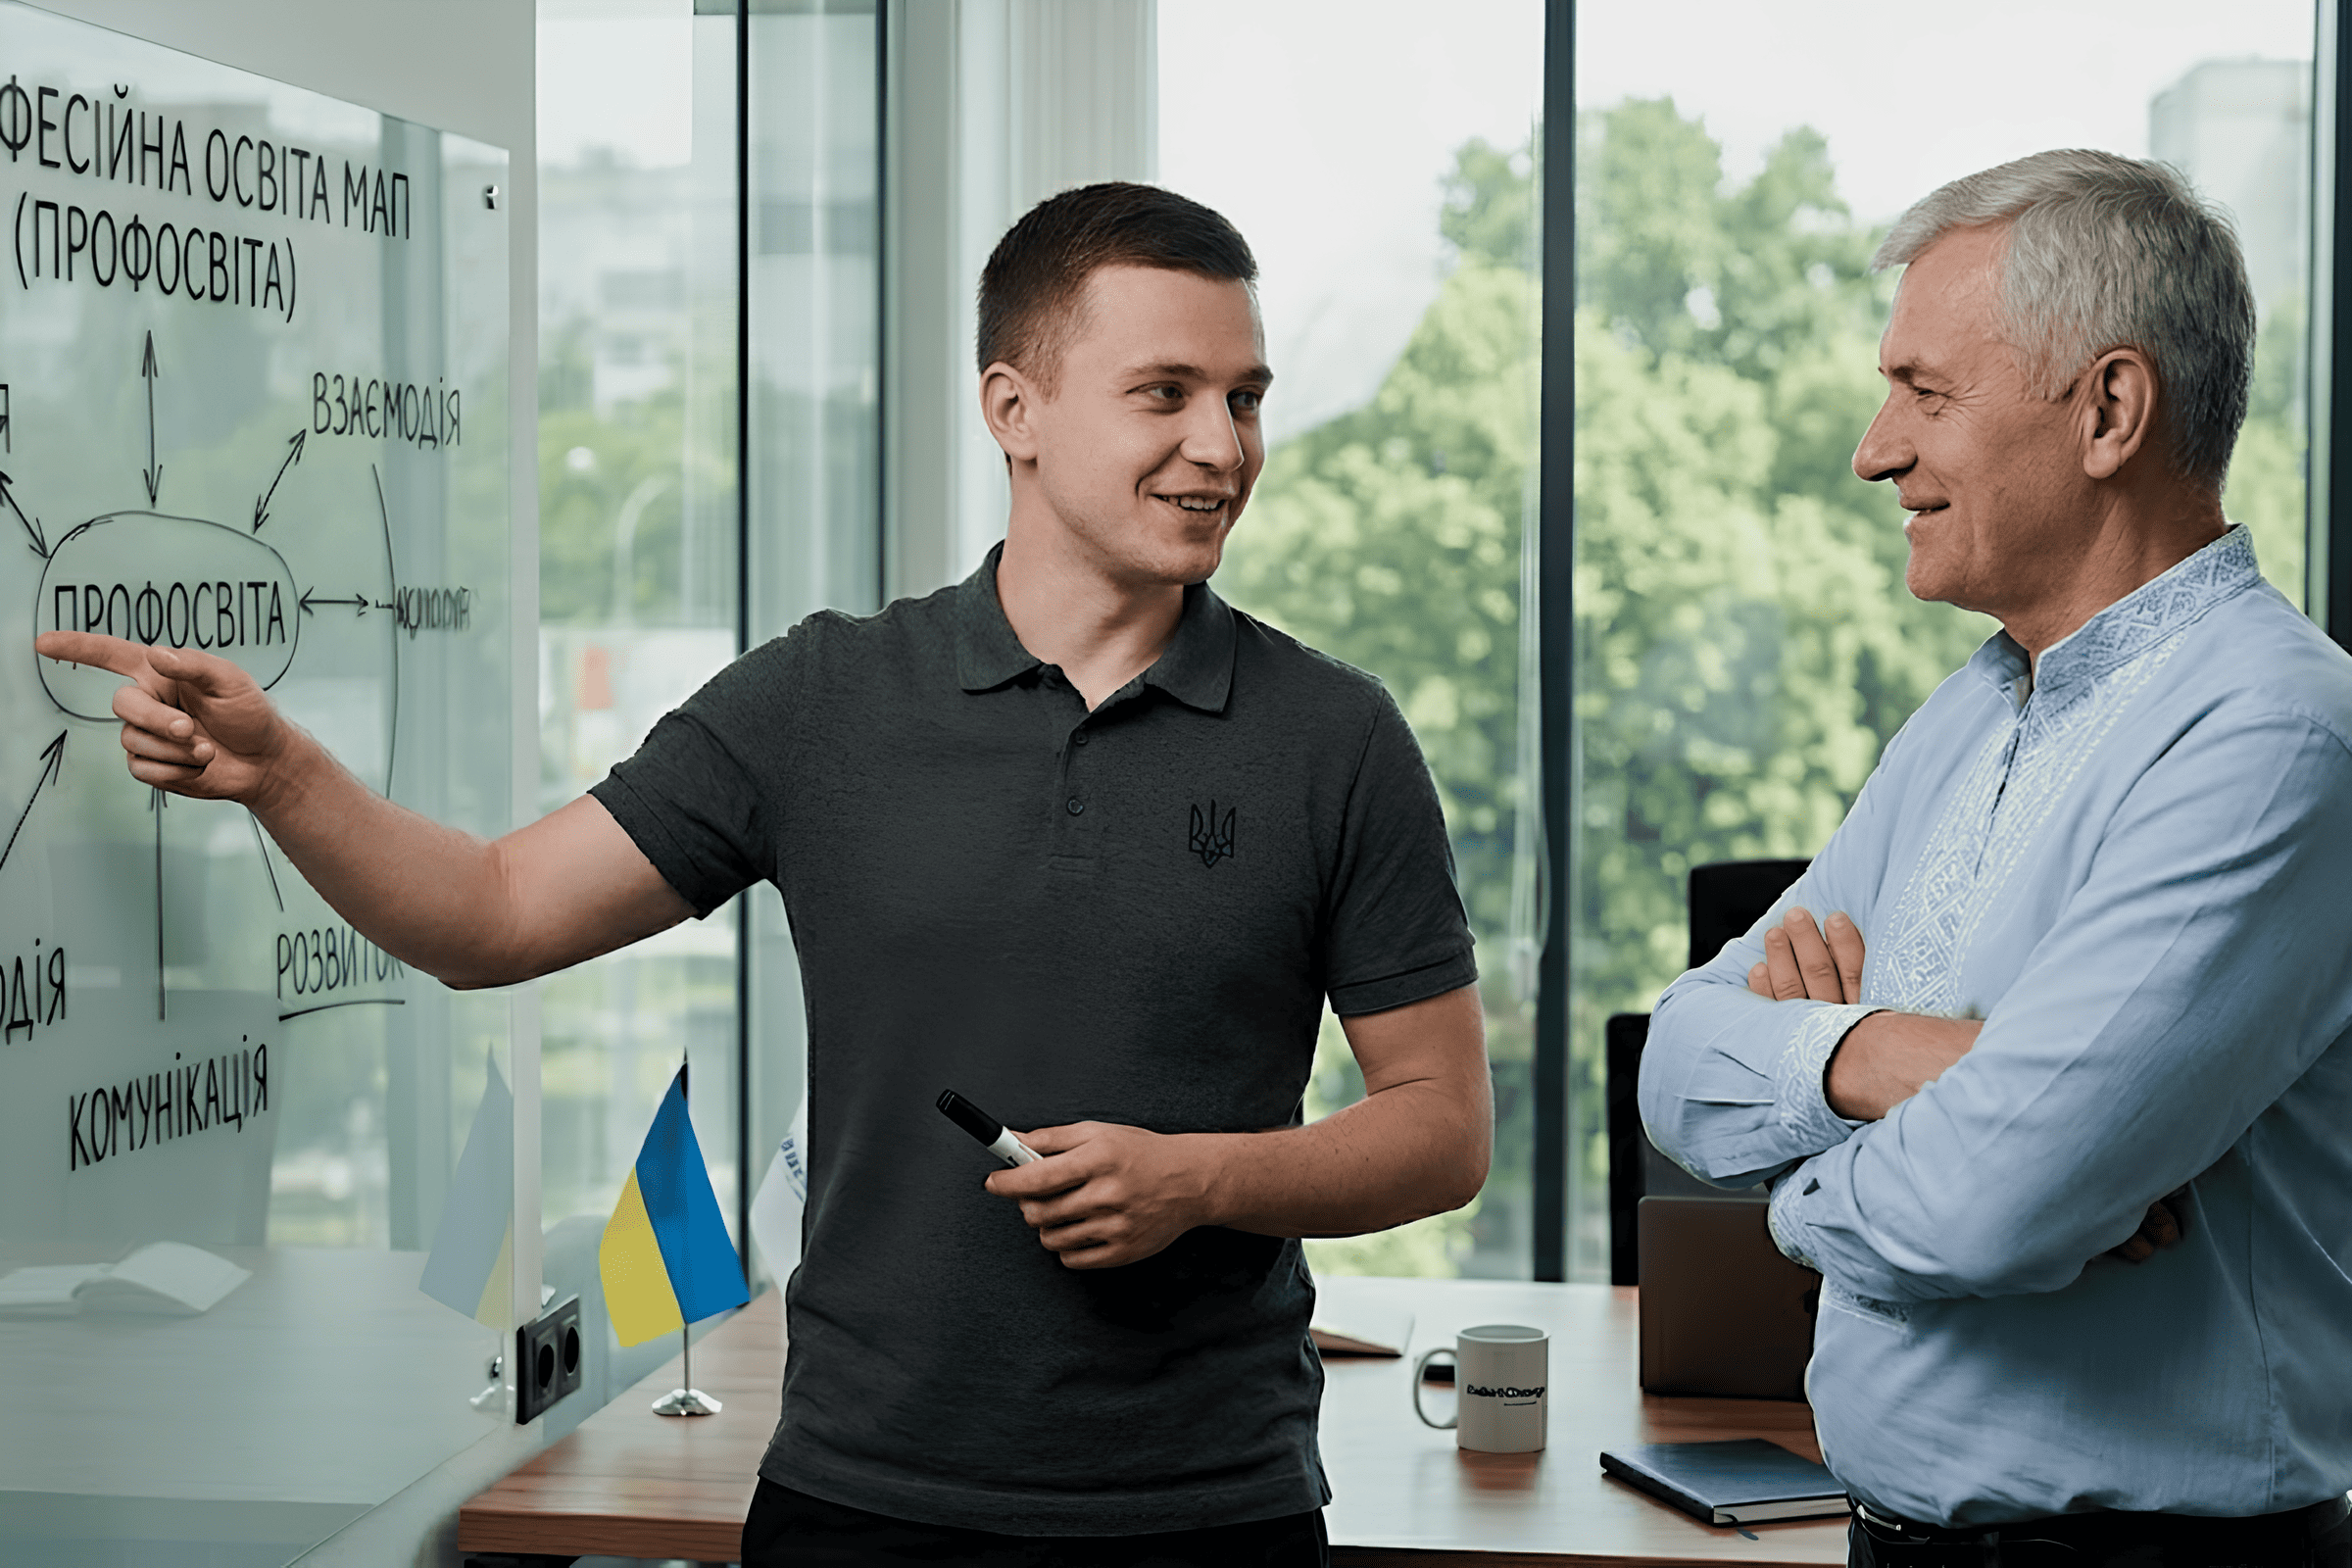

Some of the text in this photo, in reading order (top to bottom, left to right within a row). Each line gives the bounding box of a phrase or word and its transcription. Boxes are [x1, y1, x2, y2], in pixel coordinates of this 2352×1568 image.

[0, 74, 410, 240] ФЕСІЙНА ОСВІТА МАП
[15, 191, 296, 323] (ПРОФОСВІТА)
[55, 580, 286, 669] ПРОФОСВІТА
[71, 1034, 269, 1172] КОМУНІКАЦІЯ
